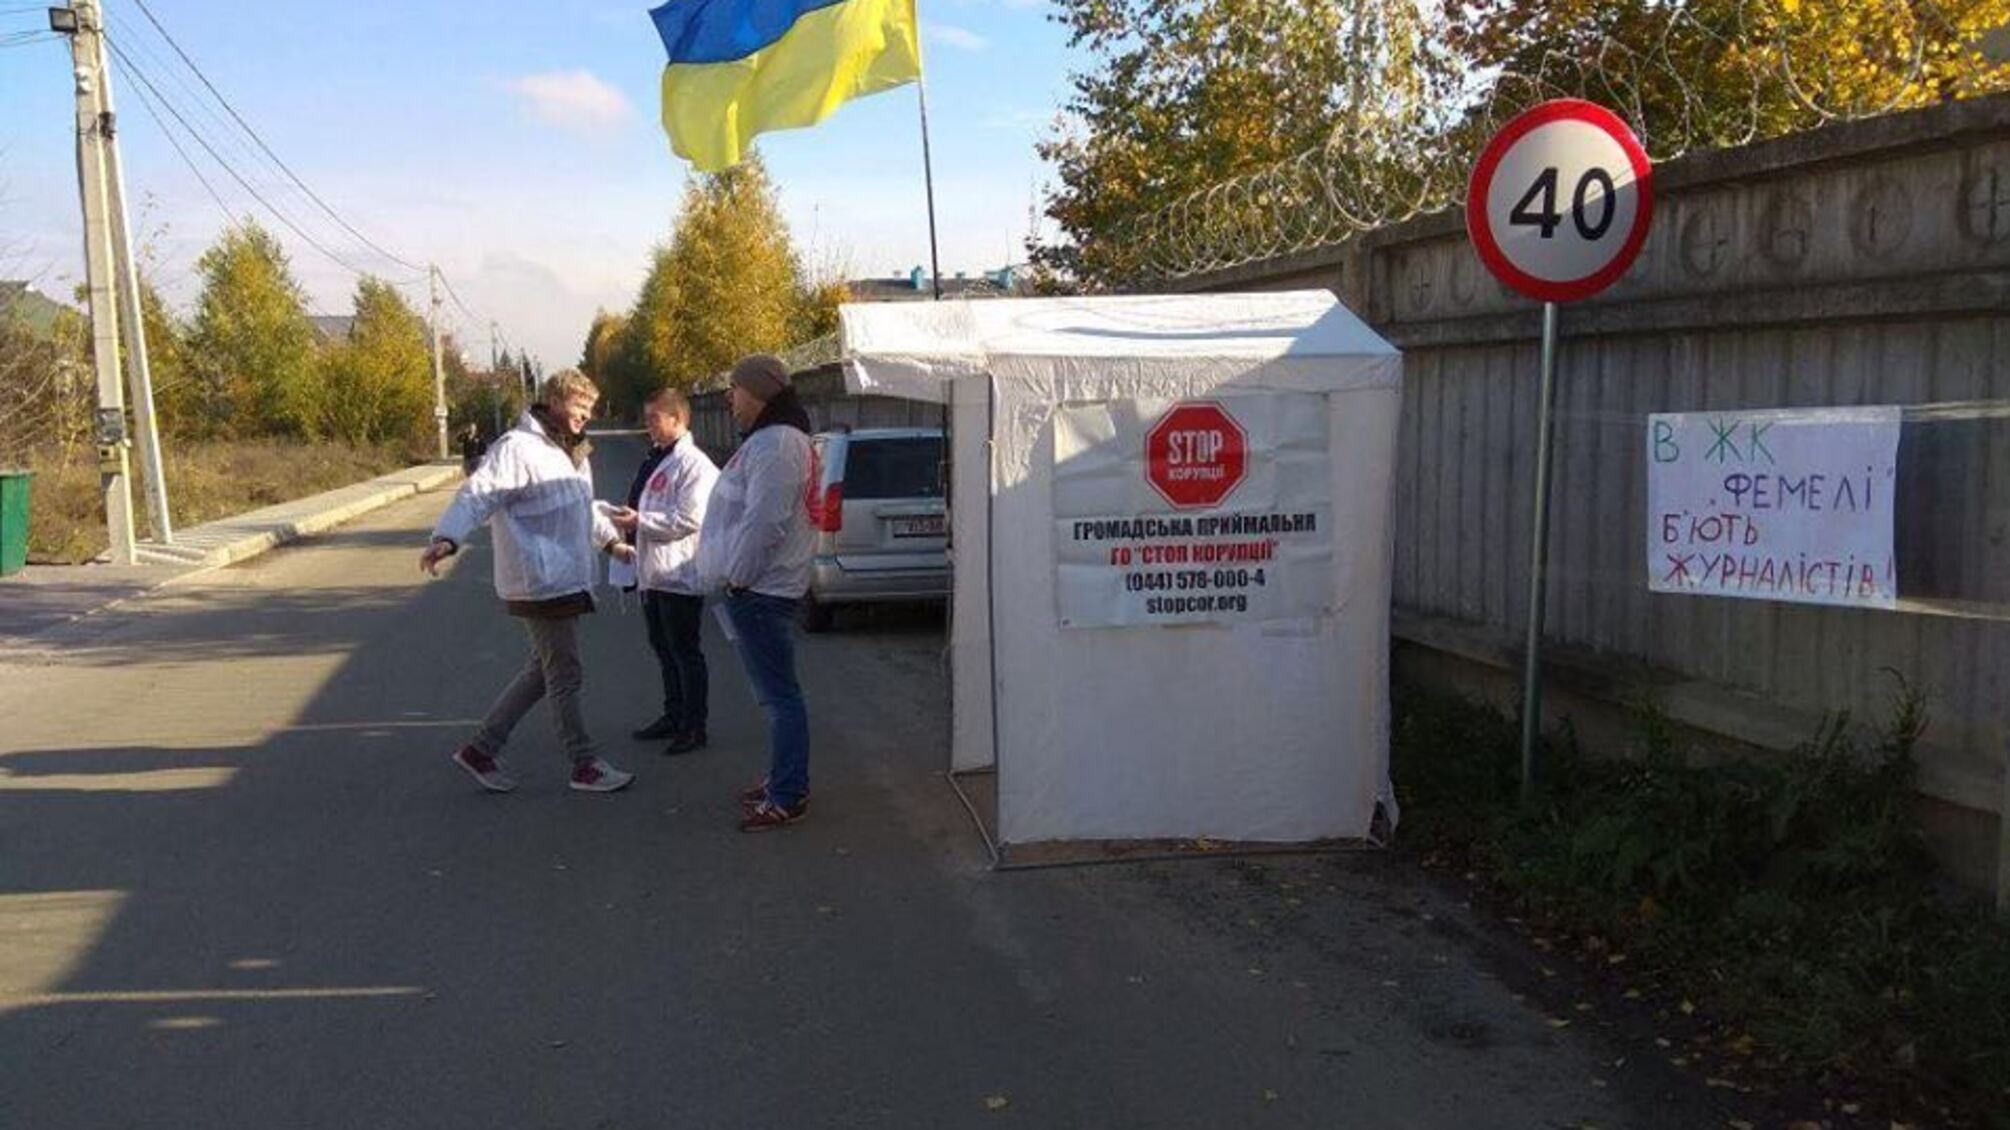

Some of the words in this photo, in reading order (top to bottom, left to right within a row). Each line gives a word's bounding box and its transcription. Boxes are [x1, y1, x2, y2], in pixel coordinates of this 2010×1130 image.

[1509, 166, 1616, 241] 40
[1168, 430, 1223, 465] STOP
[1653, 420, 1679, 463] В
[1705, 416, 1774, 465] ЖК
[1073, 517, 1194, 541] ГРОМАДСЬКА
[1196, 512, 1317, 537] ПРИЙМАЛЬНА
[1110, 545, 1132, 566] ГО
[1134, 543, 1189, 564] "СТОП
[1126, 571, 1173, 592] (044)
[1146, 593, 1248, 615] stopcor.org
